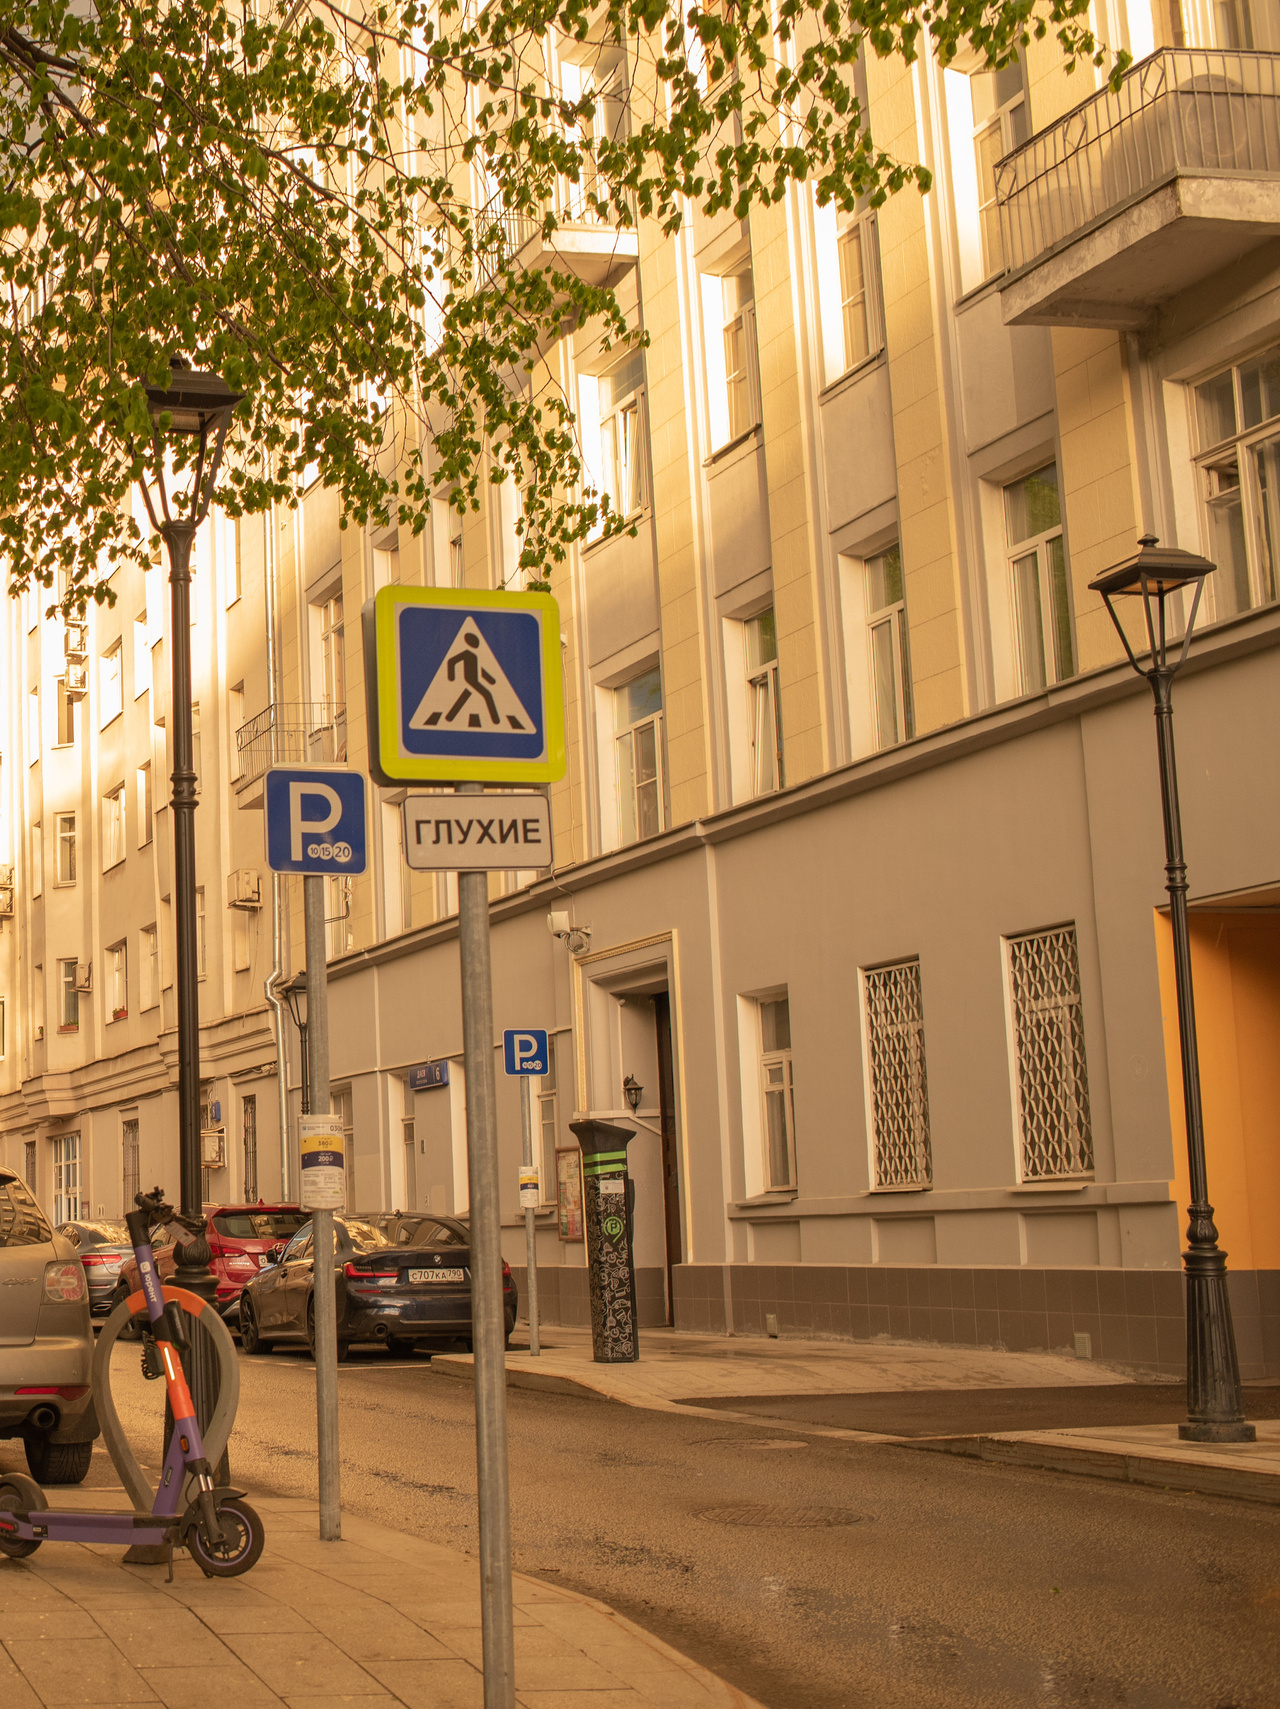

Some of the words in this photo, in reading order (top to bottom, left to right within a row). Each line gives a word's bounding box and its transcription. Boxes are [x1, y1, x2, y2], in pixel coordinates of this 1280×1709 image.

[289, 781, 342, 861] P
[415, 819, 542, 845] ГЛУХИЕ
[310, 847, 318, 855] 10
[322, 847, 331, 856] 15
[335, 846, 350, 858] 20
[513, 1034, 538, 1070] P
[435, 1067, 441, 1080] 6
[144, 1273, 157, 1303] юрент
